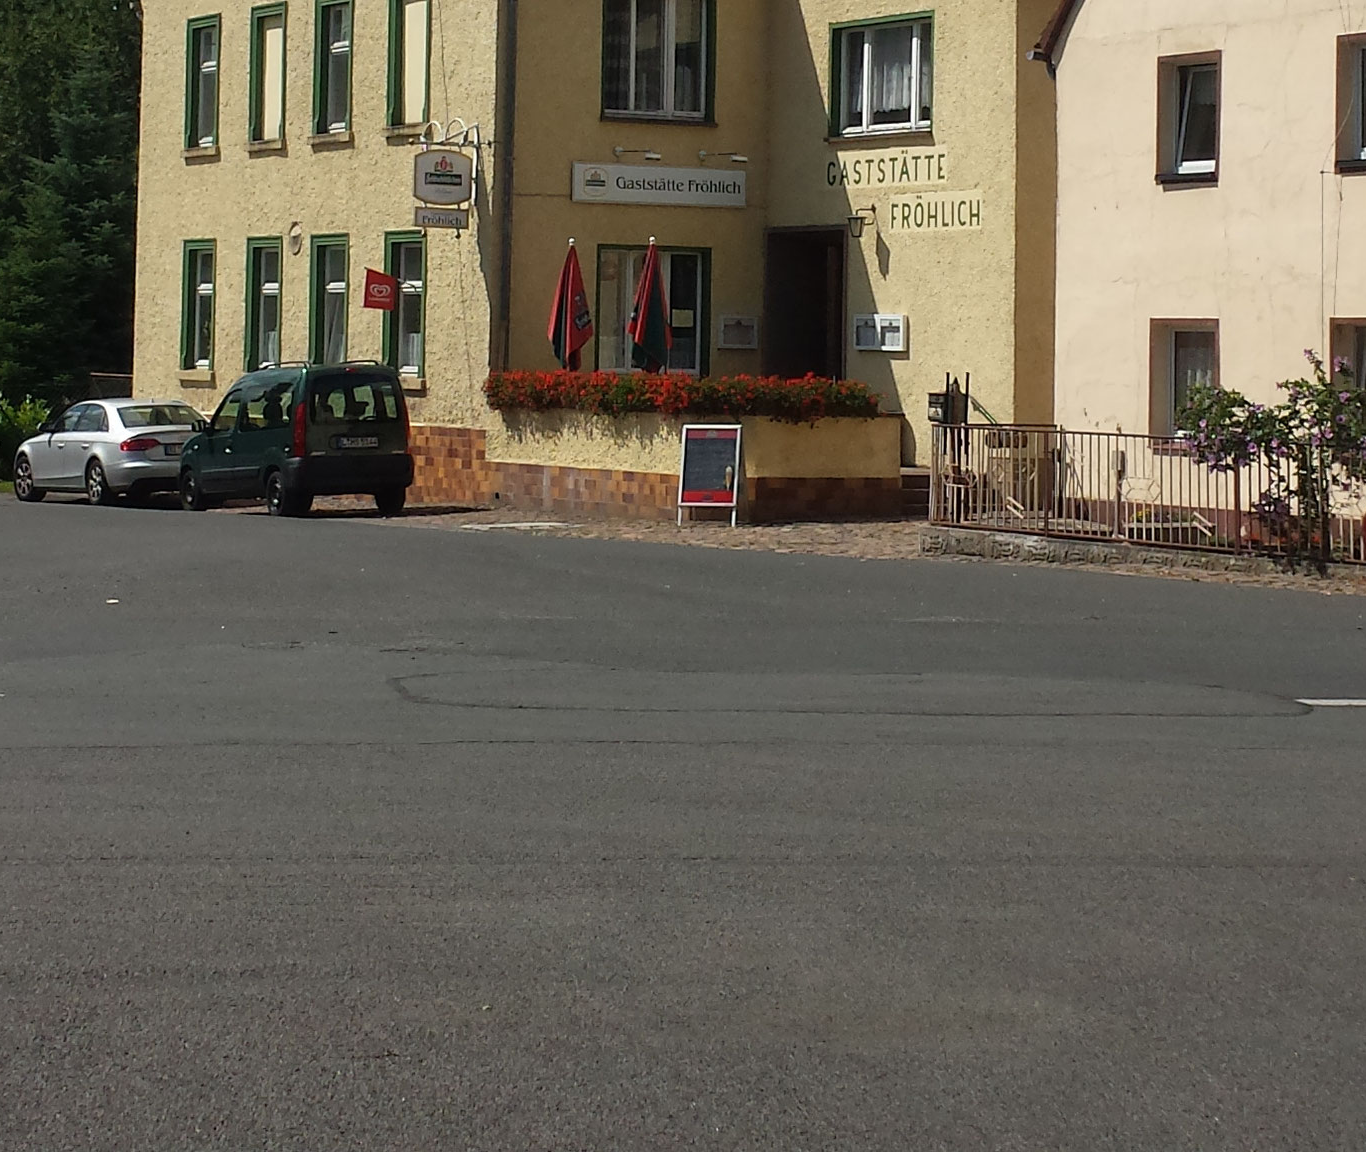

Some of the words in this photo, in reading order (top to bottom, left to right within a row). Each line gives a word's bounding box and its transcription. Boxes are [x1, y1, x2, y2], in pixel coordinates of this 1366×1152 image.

[827, 150, 946, 186] GASTSTÄTTE
[616, 176, 684, 192] Gaststätte
[688, 179, 741, 194] Fröhlich
[422, 215, 462, 226] Fröhlich
[891, 195, 980, 229] FRÖHLICH
